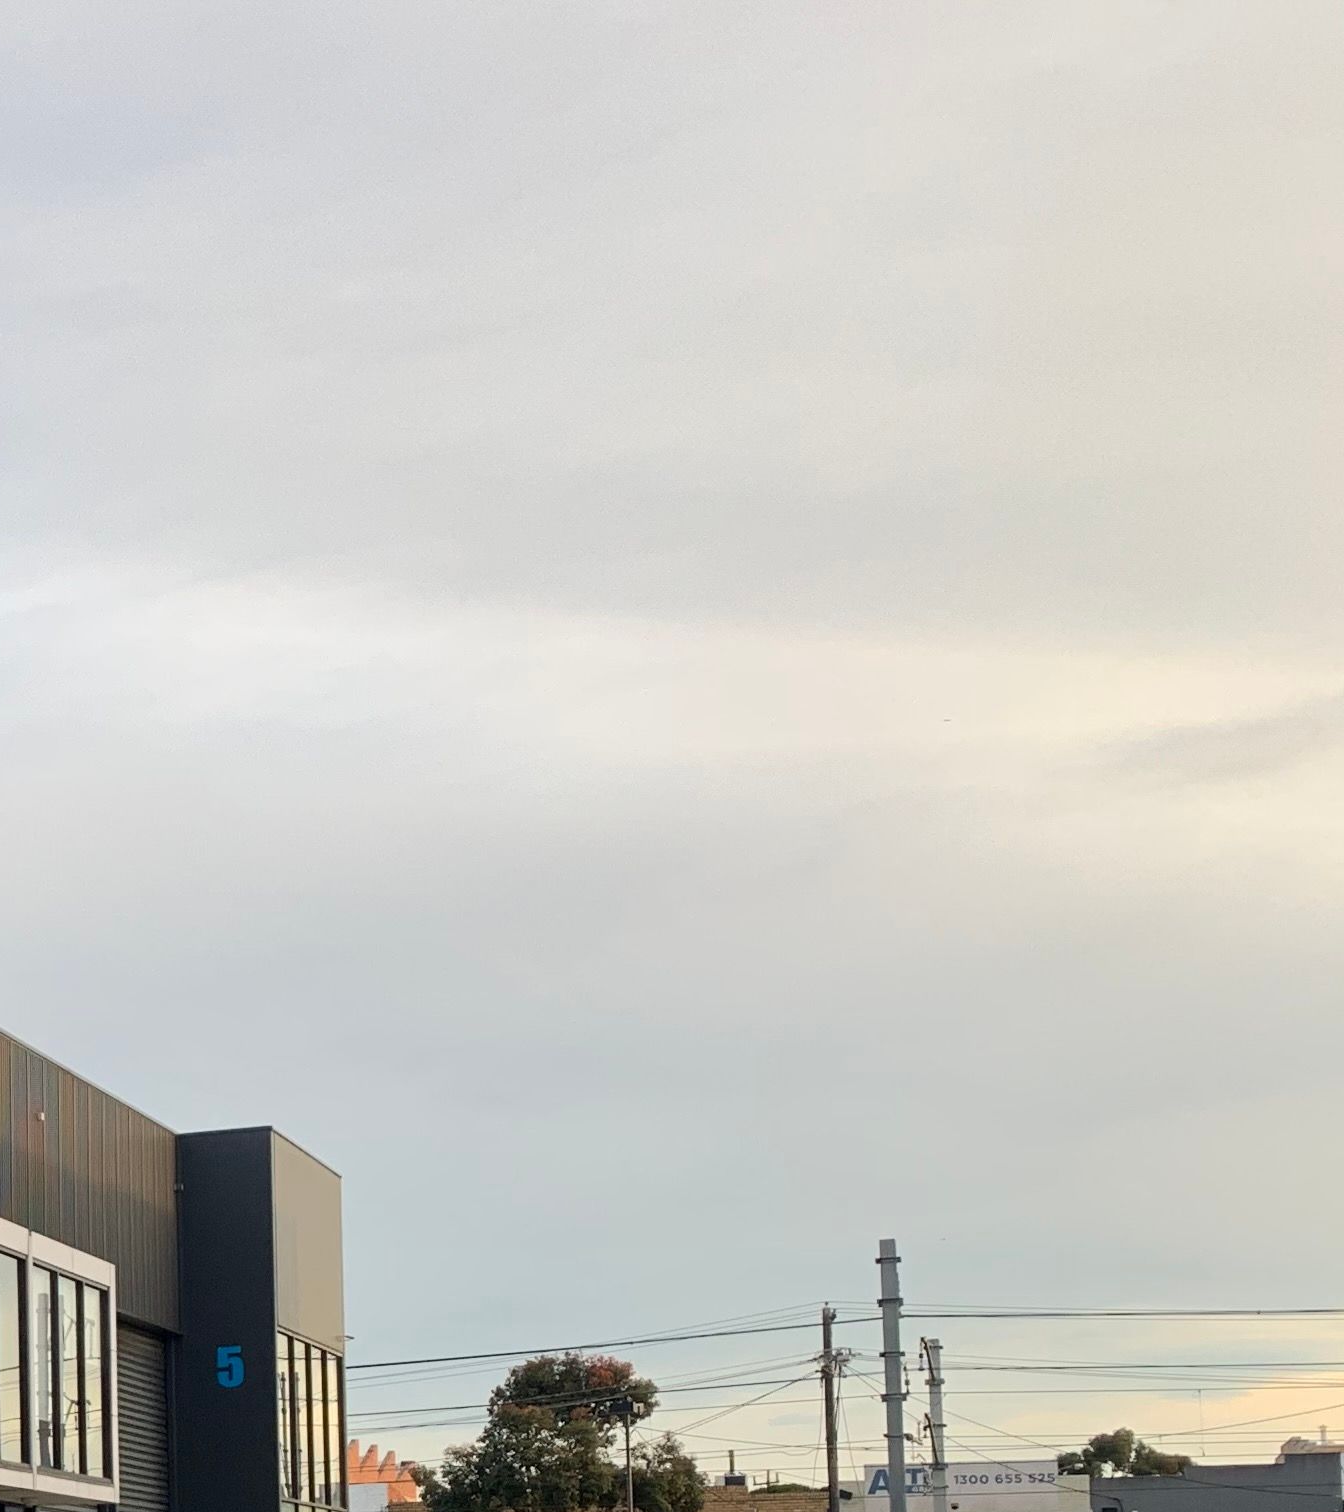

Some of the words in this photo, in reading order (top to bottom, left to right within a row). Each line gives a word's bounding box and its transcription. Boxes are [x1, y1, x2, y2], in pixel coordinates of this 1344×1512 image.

[216, 1345, 244, 1388] 5
[954, 1474, 989, 1485] 1300
[995, 1474, 1023, 1484] 655
[1029, 1472, 1056, 1483] 525
